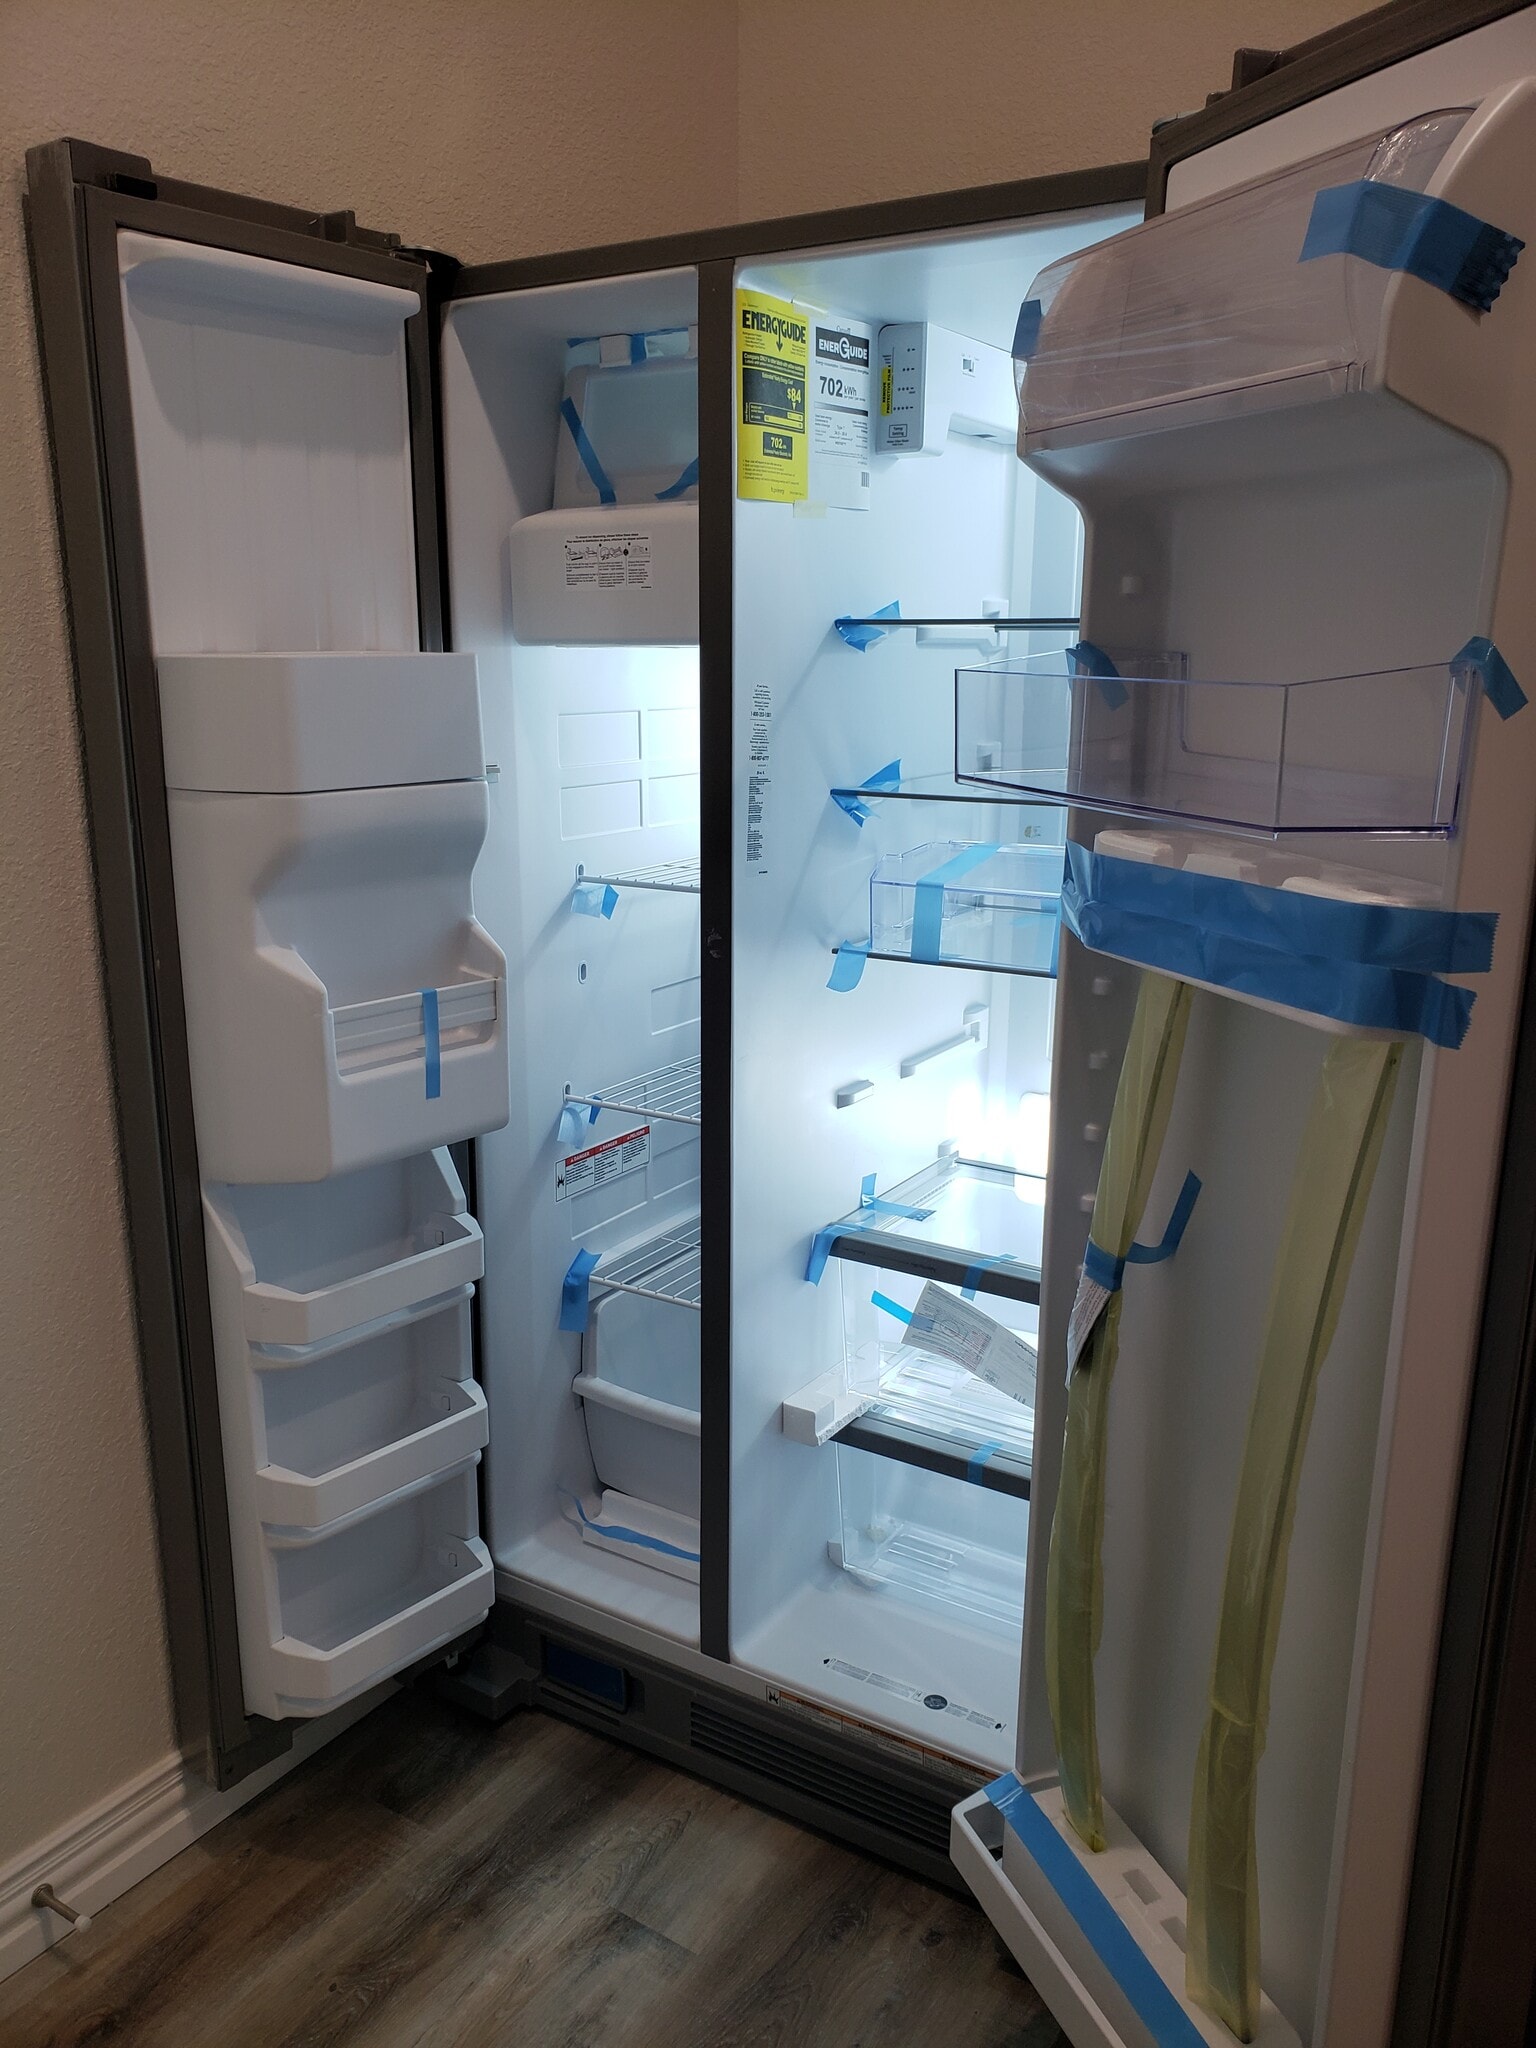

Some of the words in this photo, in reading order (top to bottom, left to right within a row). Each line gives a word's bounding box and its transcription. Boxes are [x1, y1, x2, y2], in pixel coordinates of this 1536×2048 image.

[742, 309, 806, 344] ENERGYGUIDE
[818, 337, 868, 360] ENERGUIDE
[787, 388, 801, 404] $84
[820, 376, 843, 398] 702
[844, 385, 857, 396] kWh
[770, 437, 783, 449] 702
